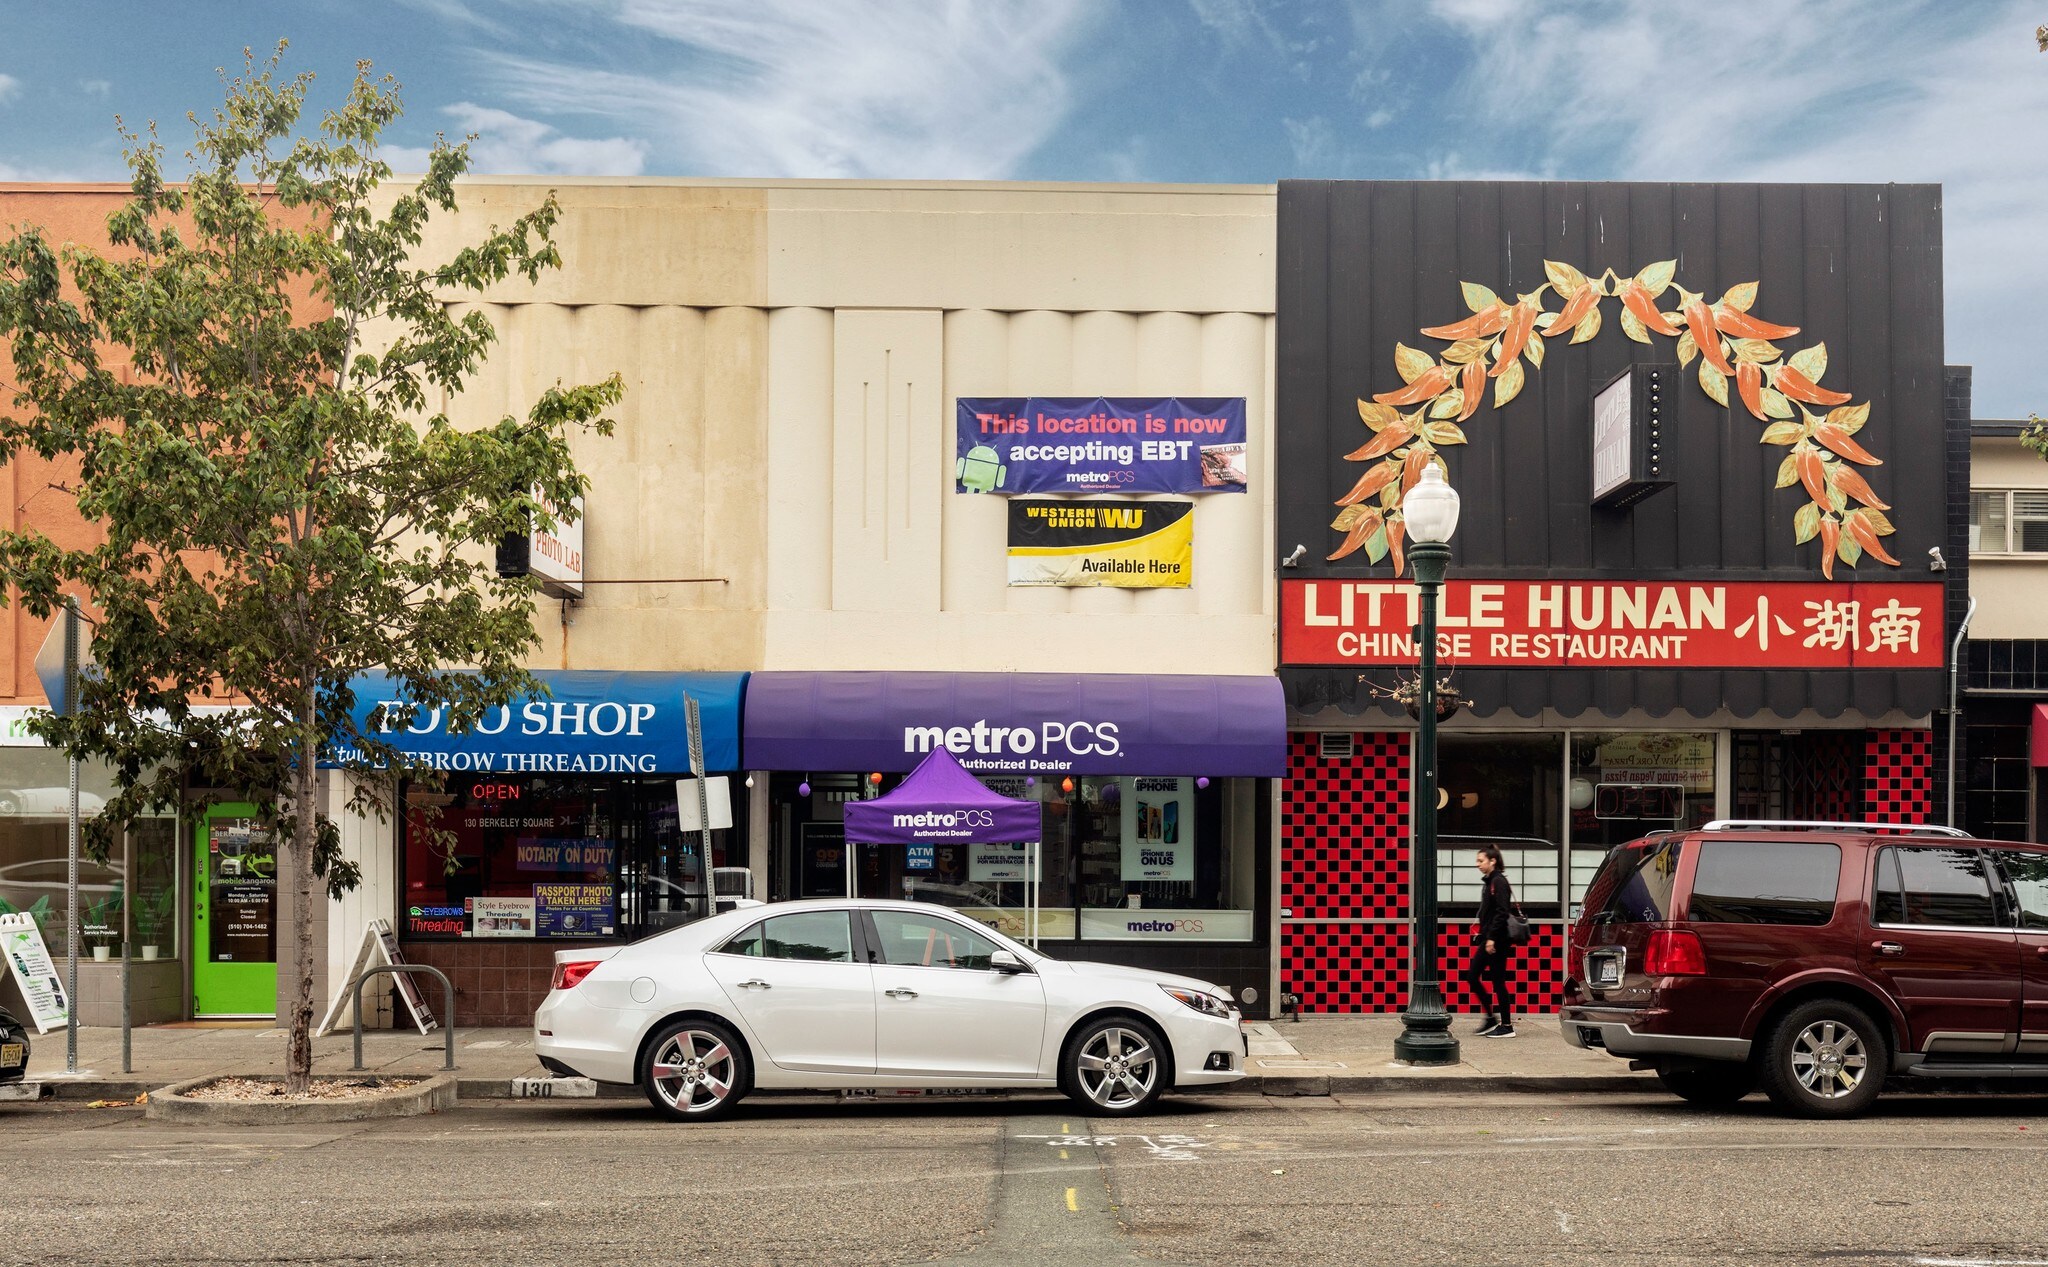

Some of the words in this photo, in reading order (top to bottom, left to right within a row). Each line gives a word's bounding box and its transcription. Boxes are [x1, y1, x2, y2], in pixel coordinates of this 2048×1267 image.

[976, 414, 1029, 433] This
[1037, 414, 1136, 434] location
[1145, 414, 1166, 433] is
[1174, 419, 1226, 434] now
[1010, 440, 1134, 465] accepting
[1141, 441, 1193, 461] EBT
[1066, 471, 1135, 483] metroPCS
[1027, 507, 1096, 518] WESTERN
[1048, 518, 1096, 528] UNION
[536, 531, 562, 563] PHOTO
[565, 546, 581, 574] LAB
[1081, 558, 1145, 573] Available
[1149, 560, 1181, 574] Here
[1305, 584, 1504, 627] LITTLE
[1528, 585, 1726, 630] HUNAN
[1734, 595, 1922, 653] 小湖南
[1337, 632, 1471, 657] CHINSE
[1490, 633, 1688, 659] RESTAURANT
[521, 701, 656, 736] SHOP
[373, 751, 496, 770] EBROW
[501, 753, 657, 772] THREADING
[1030, 759, 1072, 770] Dealer
[473, 784, 520, 799] OPEN
[1136, 783, 1178, 791] iPHONE
[1599, 787, 1682, 816] OPEN
[235, 818, 261, 829] 134
[465, 818, 477, 828] 130
[480, 818, 520, 828] BERKELEY
[523, 818, 555, 828] SQUARE
[517, 846, 560, 862] NOTARY
[565, 847, 581, 863] ON
[584, 848, 614, 864] DUTY
[908, 847, 934, 856] ATM
[1141, 857, 1157, 865] ON
[1158, 857, 1174, 865] US
[218, 877, 276, 886] mobilekangaroo
[536, 886, 581, 896] PASSPORT
[583, 886, 613, 896] PHOTO
[477, 902, 496, 911] Style
[498, 902, 531, 911] Eyebrow
[547, 897, 575, 905] TAKEN
[578, 897, 601, 905] HERE
[423, 907, 464, 916] EYEBROWS
[409, 918, 464, 935] Threading
[1127, 920, 1203, 932] metroPCS
[522, 1082, 552, 1098] 130
